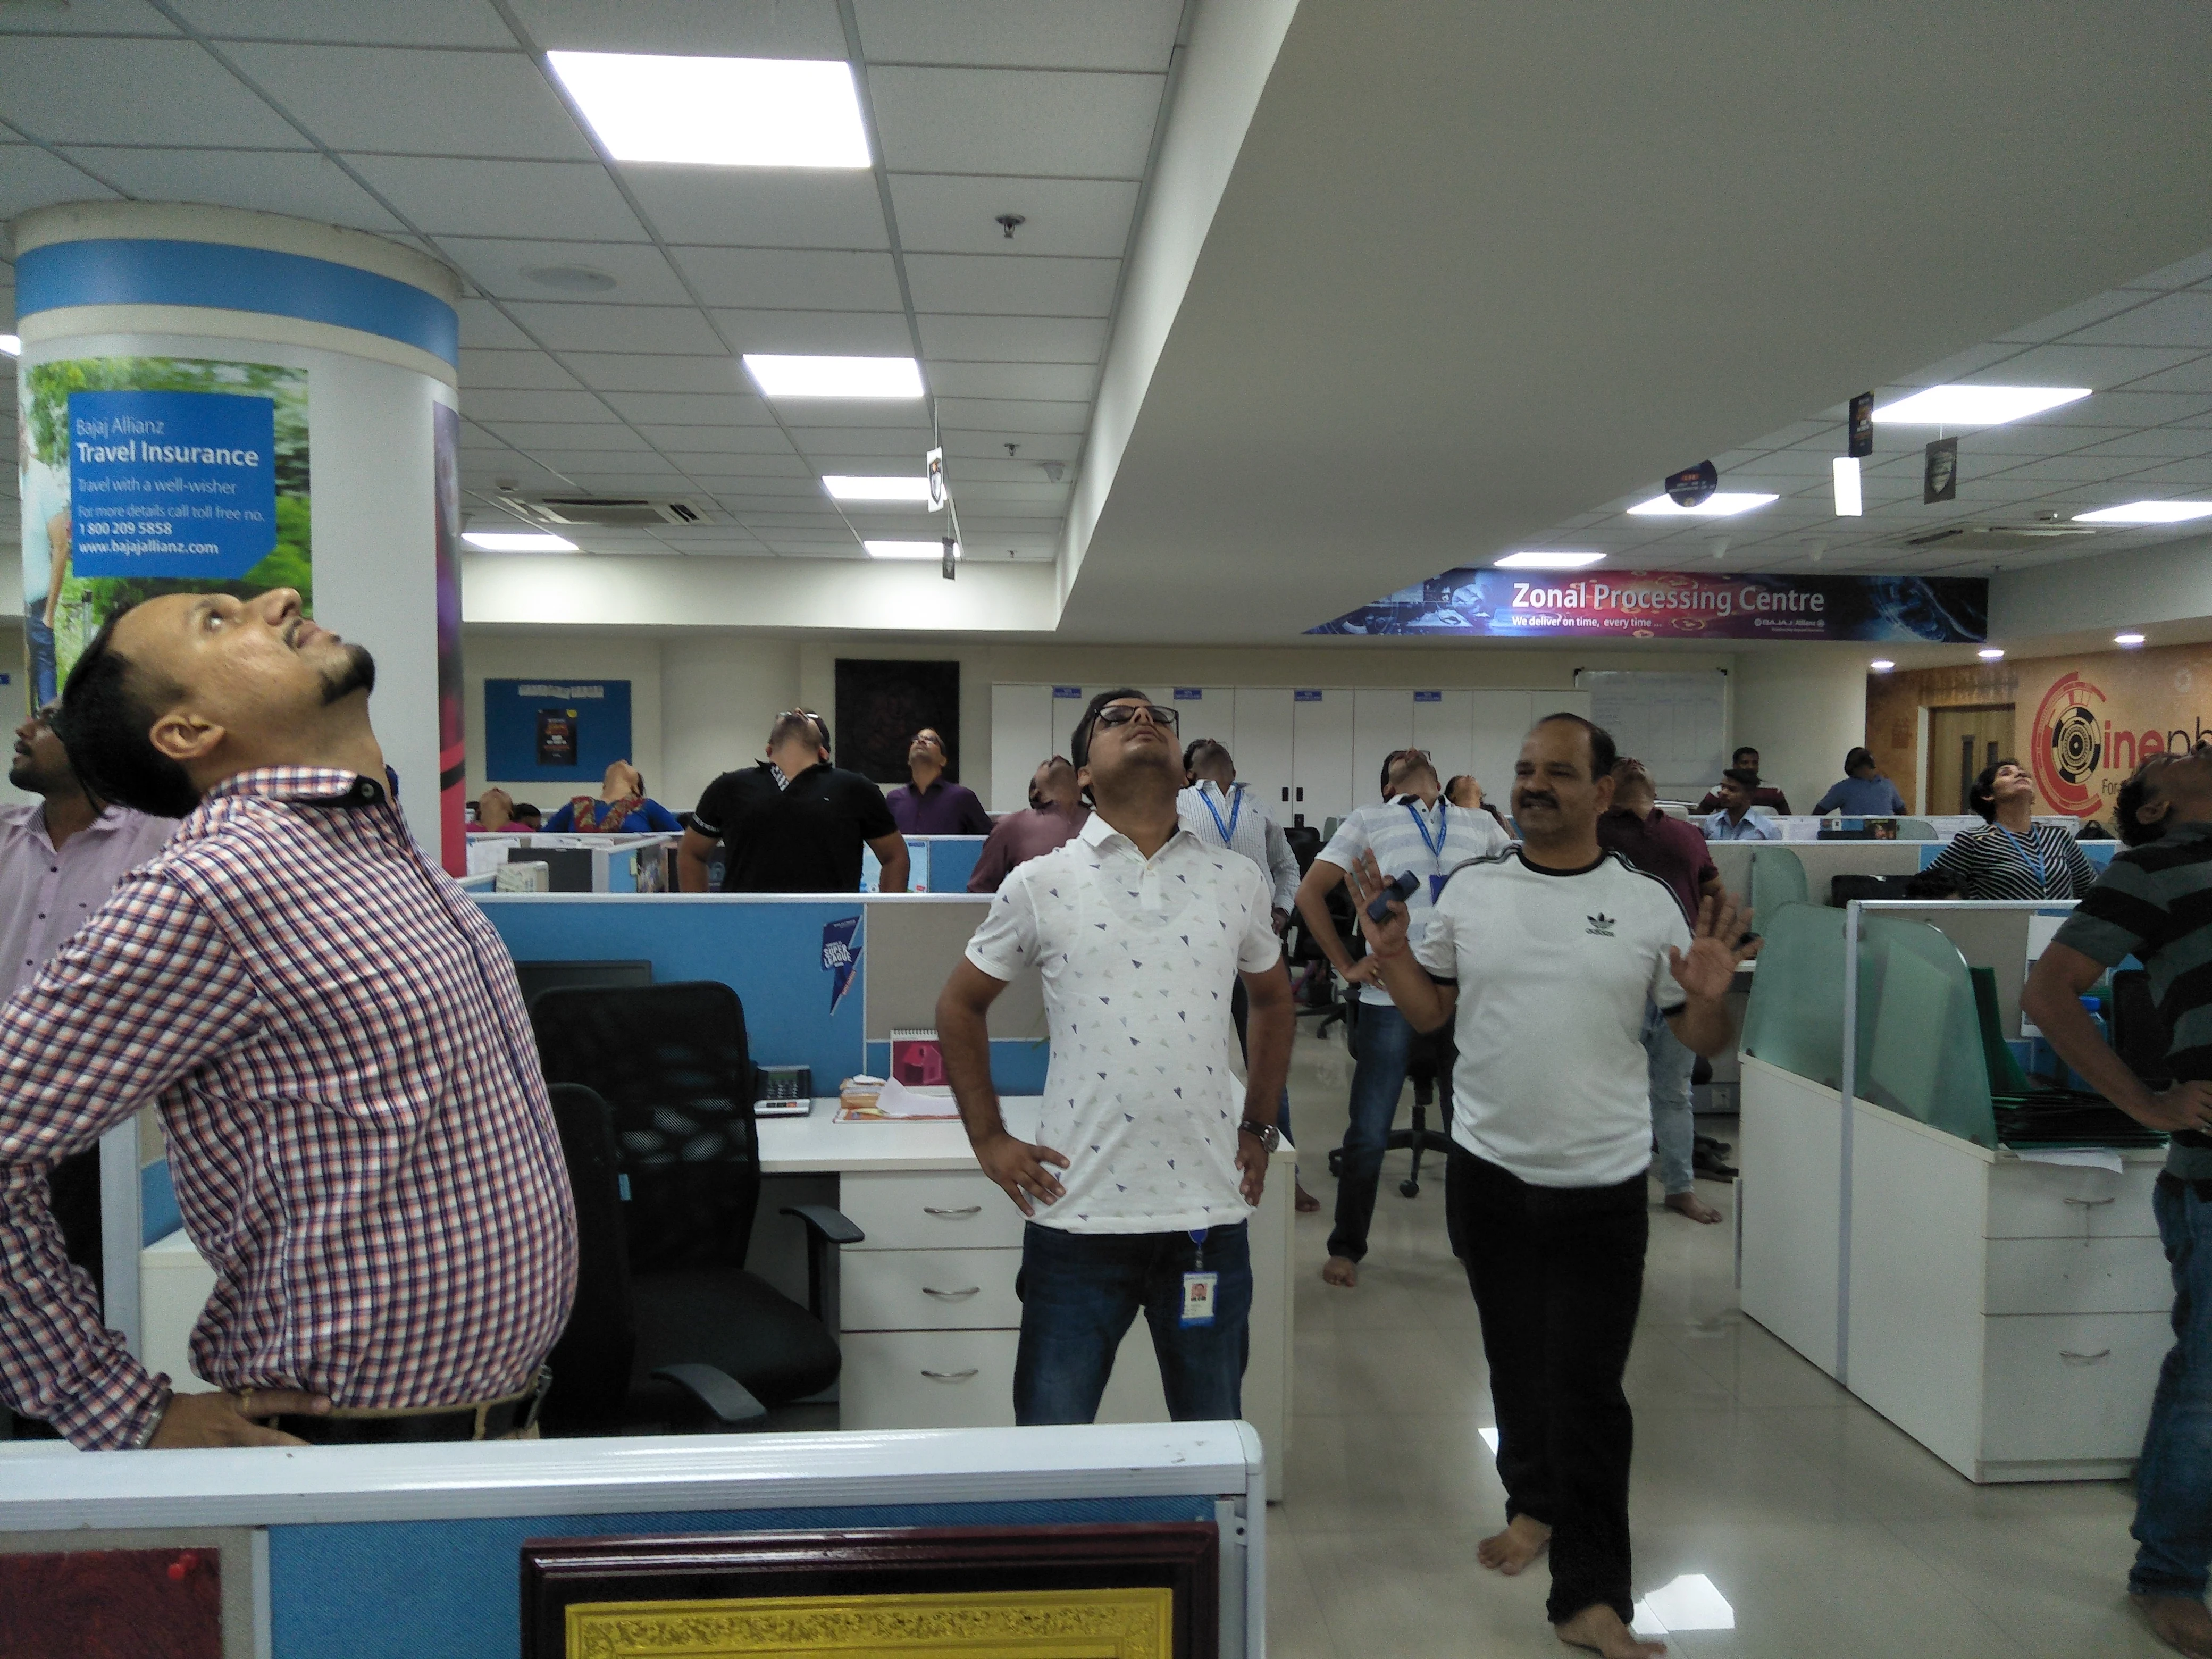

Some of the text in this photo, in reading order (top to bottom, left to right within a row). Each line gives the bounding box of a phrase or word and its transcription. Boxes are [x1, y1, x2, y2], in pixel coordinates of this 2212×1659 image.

[77, 415, 165, 439] Bajaj Allianz
[77, 439, 259, 467] Travel Insurance
[78, 477, 237, 495] Travel with a well-wisher
[79, 504, 265, 522] For more details call toll free no.
[80, 522, 173, 536] 1 800 209 5858
[80, 539, 219, 556] www.bajajallianz.com
[1512, 582, 1825, 617] Zonal Processing Centre
[1512, 616, 1528, 626] We
[1529, 616, 1561, 627] deliver
[1576, 616, 1600, 628] time,
[1604, 619, 1629, 630] every
[1630, 617, 1652, 627] time
[2101, 778, 2118, 795] For
[824, 944, 848, 956] SUPER
[824, 952, 852, 968] LEAGUE
